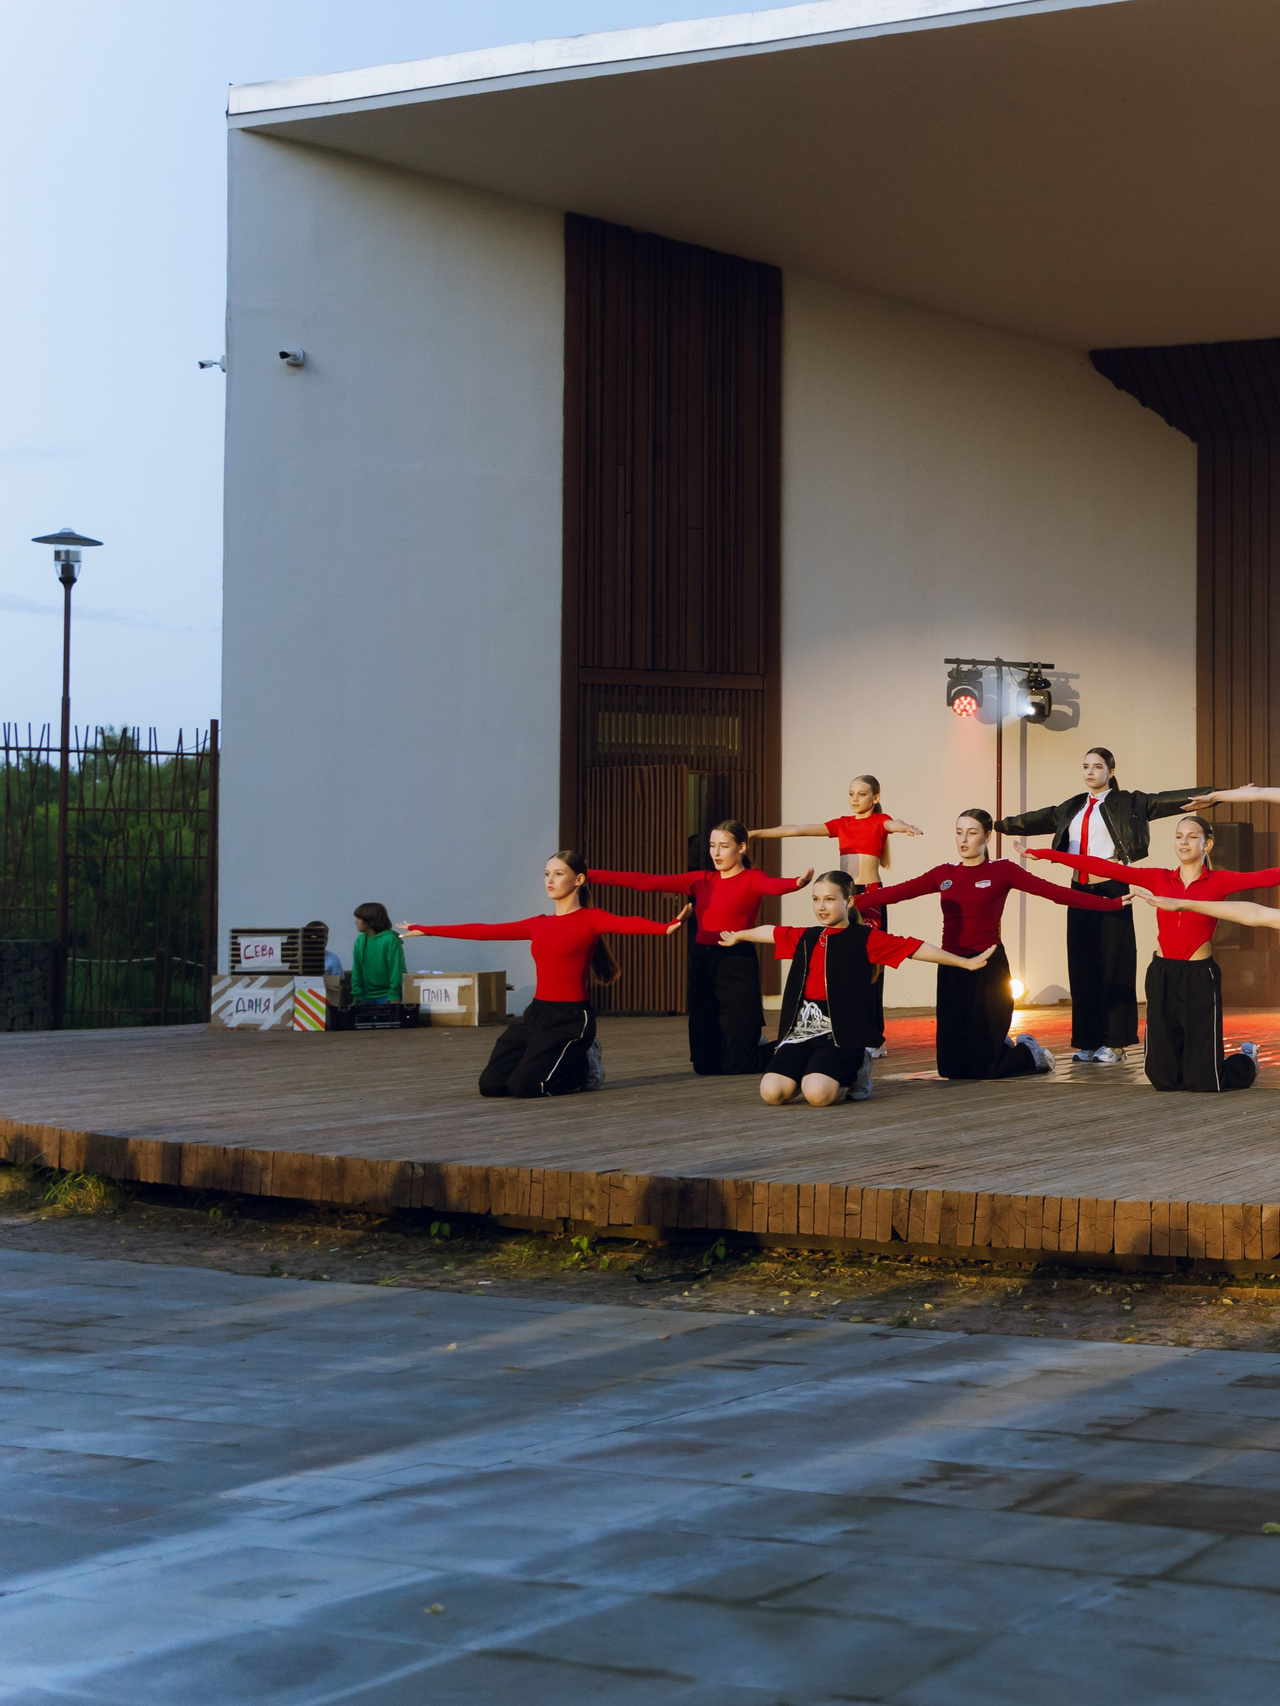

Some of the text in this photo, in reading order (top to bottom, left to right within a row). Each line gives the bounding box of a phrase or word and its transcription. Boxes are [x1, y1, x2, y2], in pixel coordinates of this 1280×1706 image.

[243, 944, 274, 960] СЕВА
[422, 988, 451, 1003] ПАПА
[235, 996, 271, 1015] ДАНЯ
